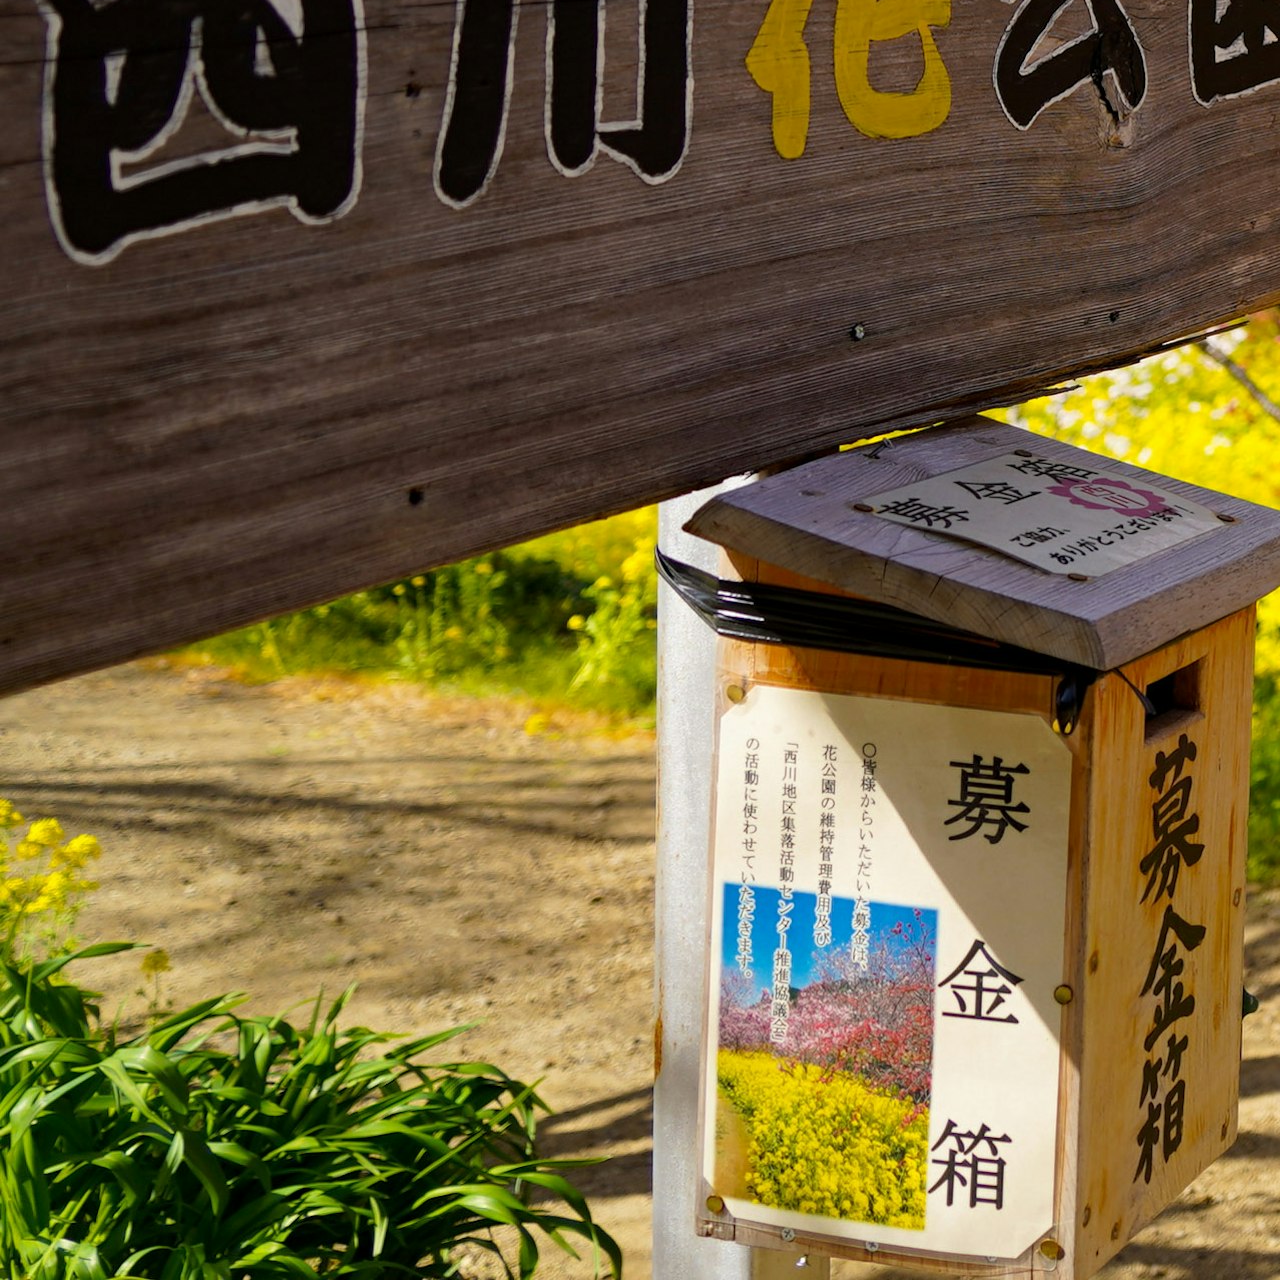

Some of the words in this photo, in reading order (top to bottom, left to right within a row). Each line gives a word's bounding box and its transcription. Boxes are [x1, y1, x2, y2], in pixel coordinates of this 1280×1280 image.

[876, 458, 1099, 529] 募金箱
[1081, 485, 1145, 508] 西川
[736, 737, 760, 978] の活動に使わせていただきます。
[771, 741, 799, 1041] 「西川地区集落活動センター推進協議会」
[815, 744, 838, 946] 花公園の維持管理費用及び
[1133, 733, 1206, 1185] 募金箱
[928, 753, 1031, 1210] 募金箱
